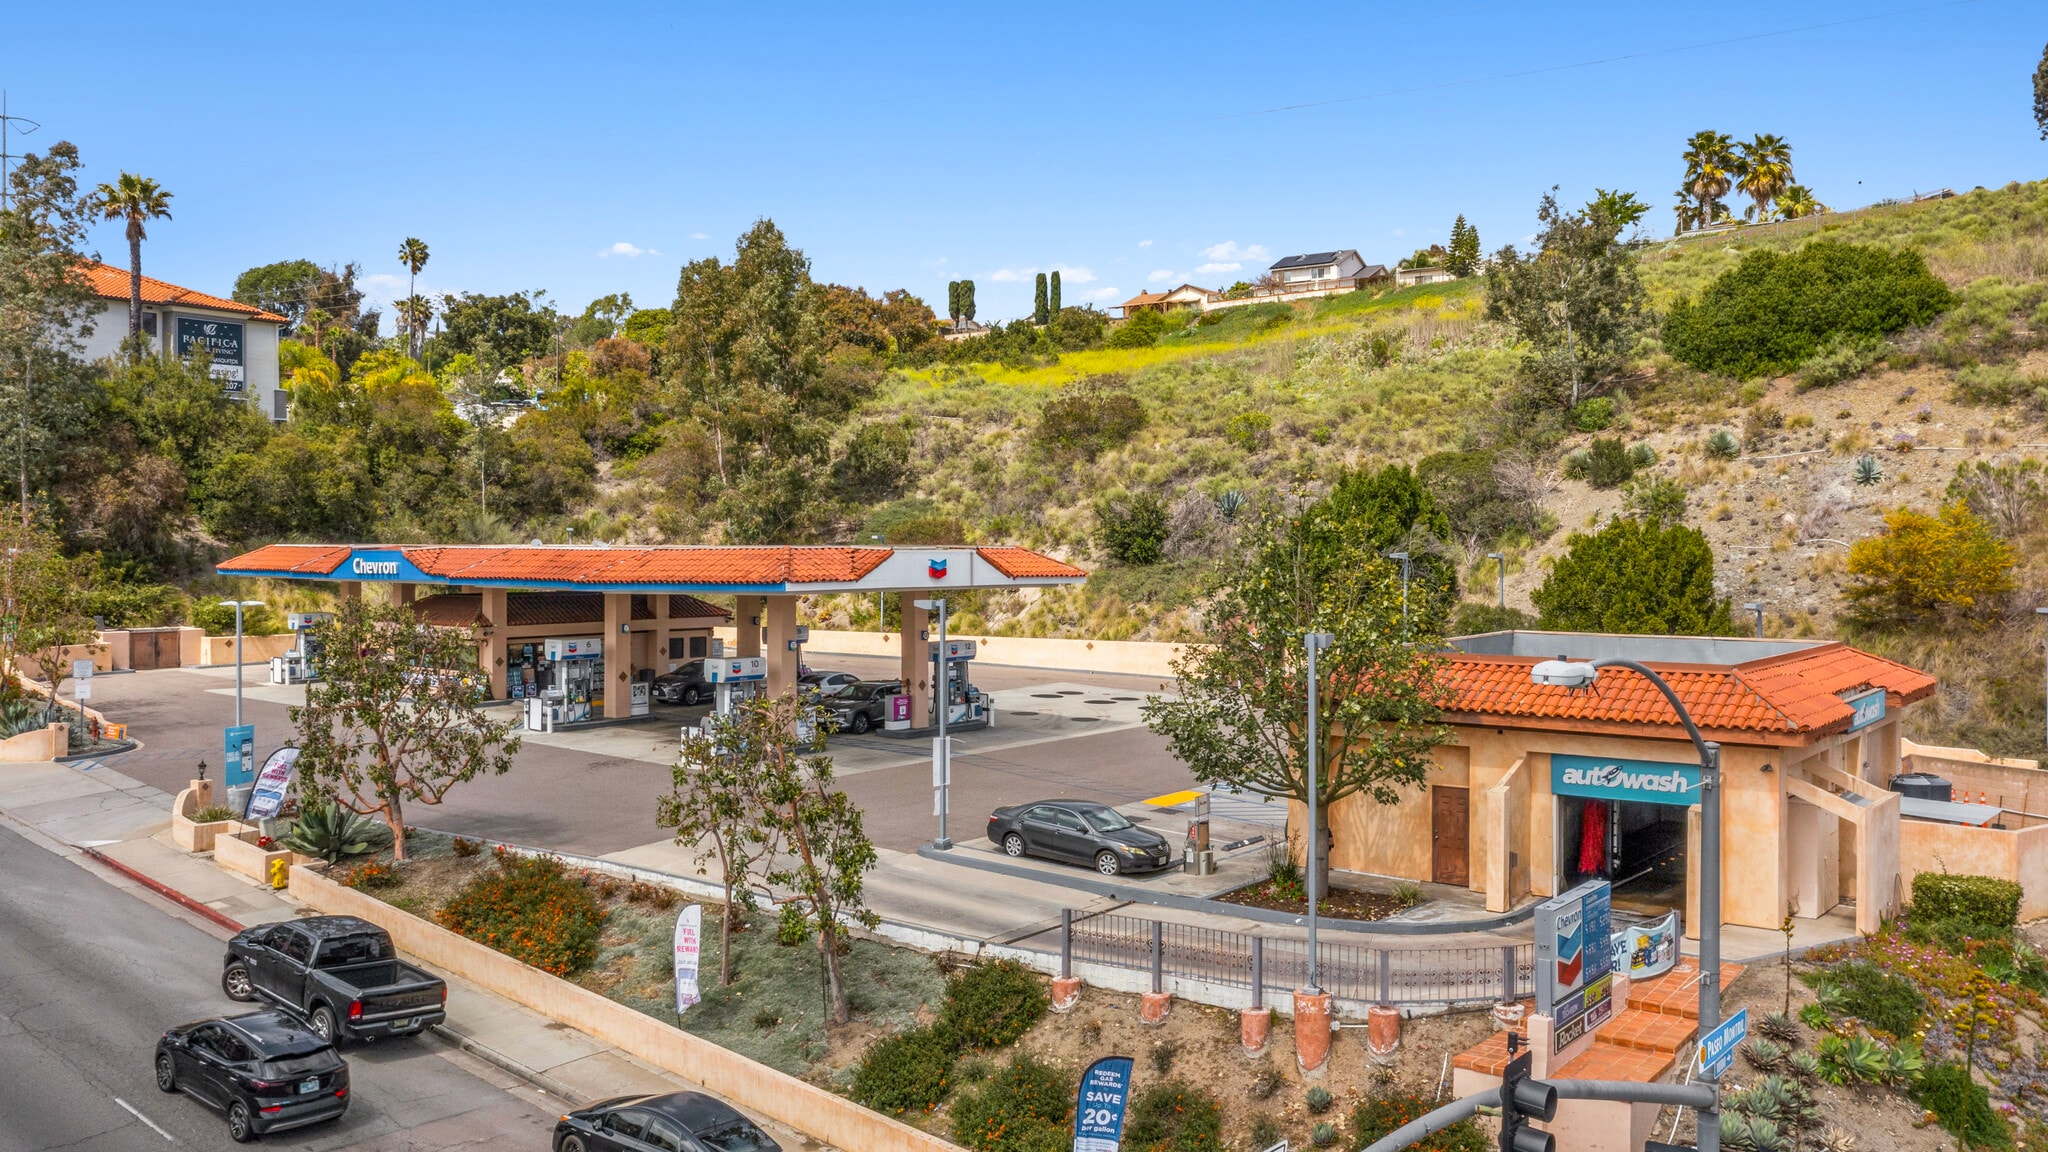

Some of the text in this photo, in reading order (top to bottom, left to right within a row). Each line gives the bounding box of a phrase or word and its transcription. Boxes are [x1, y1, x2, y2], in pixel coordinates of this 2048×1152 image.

[183, 335, 238, 348] PACIFICA
[211, 369, 239, 379] easing!
[353, 557, 397, 575] Chevron
[586, 640, 592, 648] 6
[750, 660, 760, 668] 10
[1562, 765, 1688, 793] autowash
[1557, 908, 1582, 930] Chevron
[683, 928, 696, 936] FUEL
[1610, 940, 1628, 956] AVE
[1558, 1020, 1583, 1049] Rocket
[1094, 1069, 1121, 1078] REDEEM
[1086, 1091, 1122, 1105] SAVE
[1093, 1126, 1115, 1134] gallon
